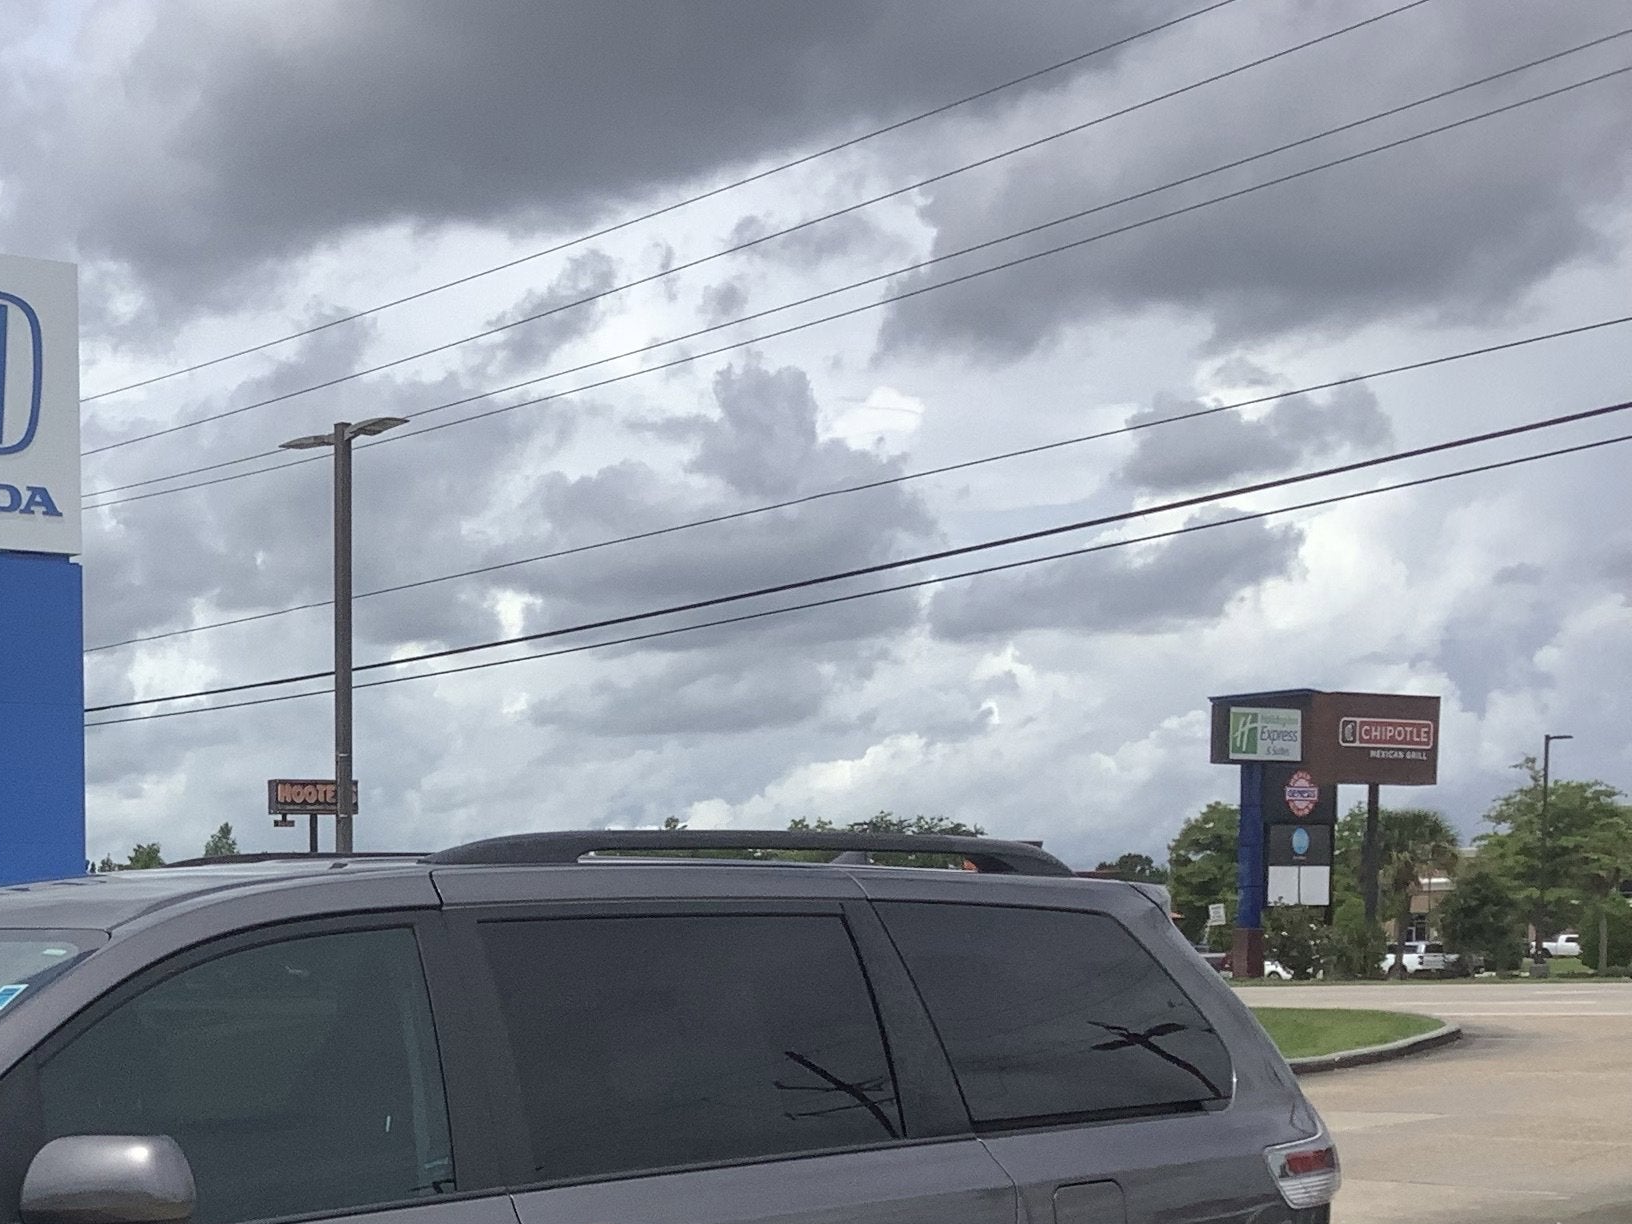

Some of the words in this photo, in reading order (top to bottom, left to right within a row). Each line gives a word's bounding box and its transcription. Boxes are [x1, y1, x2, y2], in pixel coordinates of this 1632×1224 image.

[1260, 726, 1298, 744] Express
[1361, 725, 1429, 742] CHIPOTLE
[1369, 750, 1404, 758] MEXICAN
